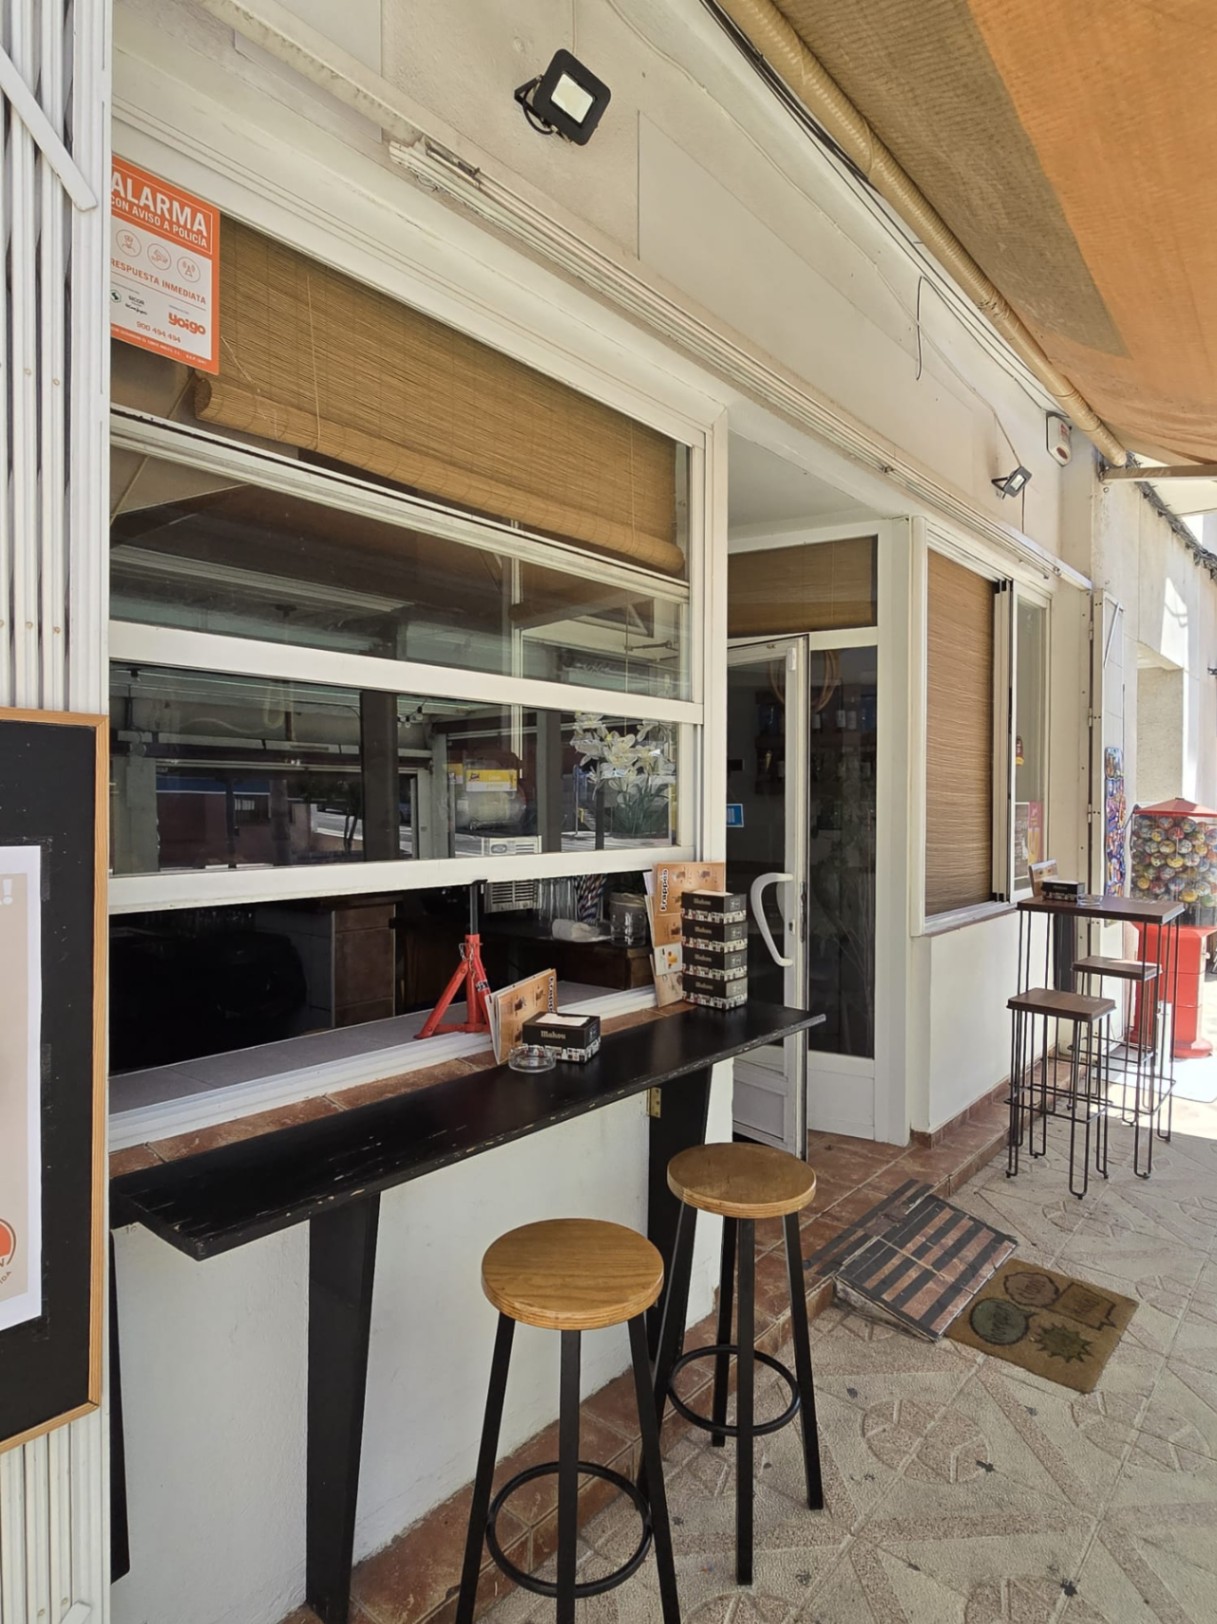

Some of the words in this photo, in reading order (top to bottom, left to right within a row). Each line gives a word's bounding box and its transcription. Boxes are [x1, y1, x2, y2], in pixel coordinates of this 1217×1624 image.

[111, 171, 207, 237] ALARMA
[132, 206, 160, 226] AVISO
[163, 220, 170, 231] A
[172, 225, 207, 248] POLICÍA
[162, 280, 206, 304] INMEDIATA
[168, 312, 206, 335] yoigo
[540, 1030, 566, 1039] Mahou
